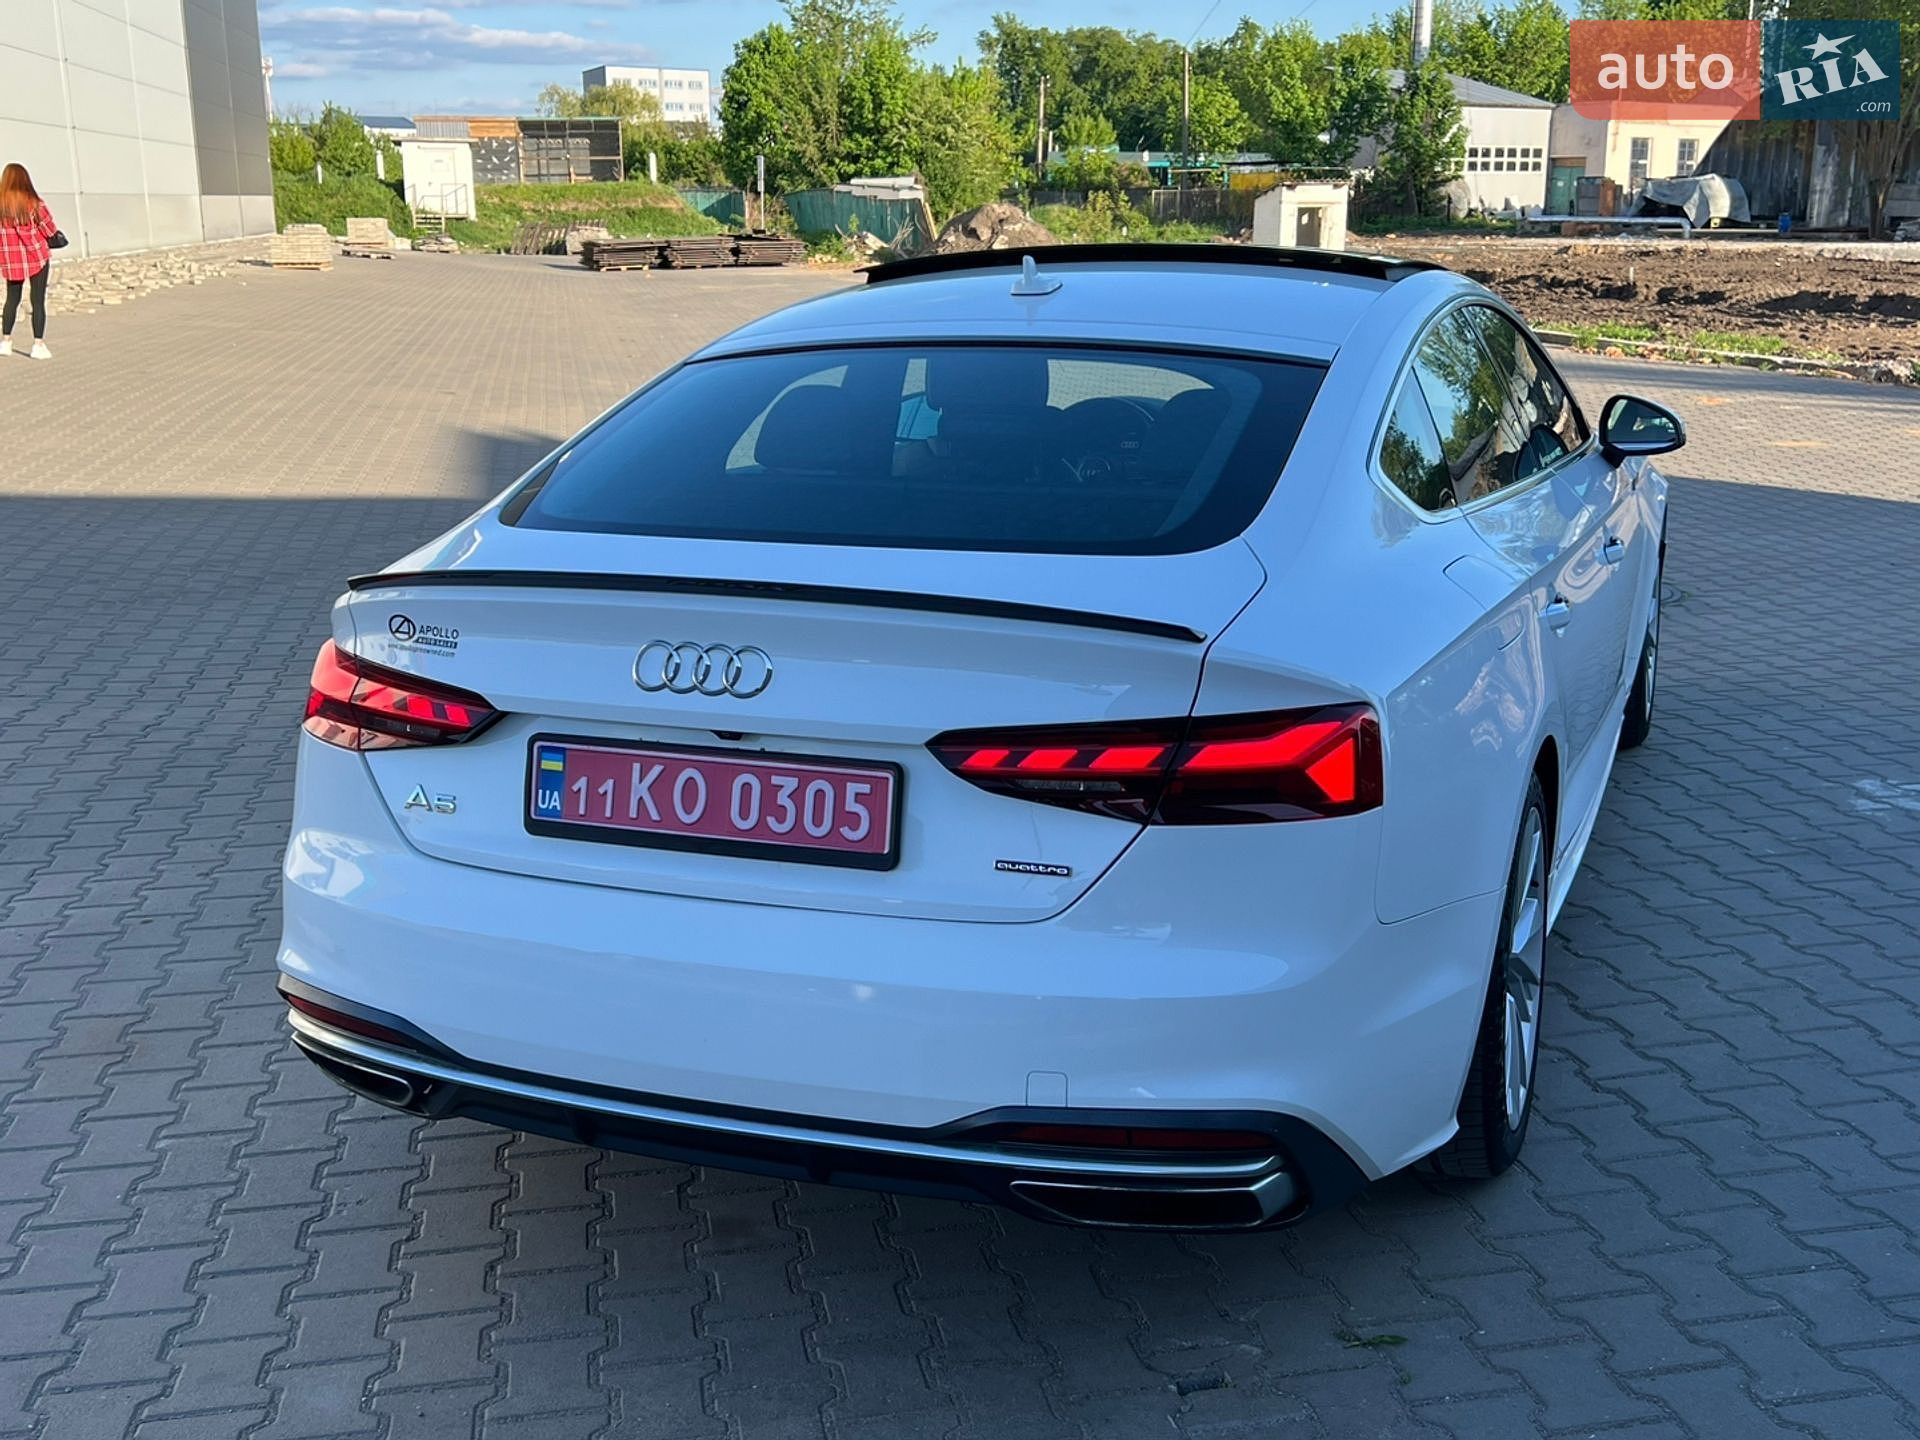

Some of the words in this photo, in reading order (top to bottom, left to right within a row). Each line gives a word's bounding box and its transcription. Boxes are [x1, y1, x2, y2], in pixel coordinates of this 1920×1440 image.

[419, 625, 459, 640] APOLLO
[404, 784, 456, 814] A5
[538, 789, 561, 811] UA
[730, 773, 872, 843] 0305
[997, 861, 1069, 875] quattro
